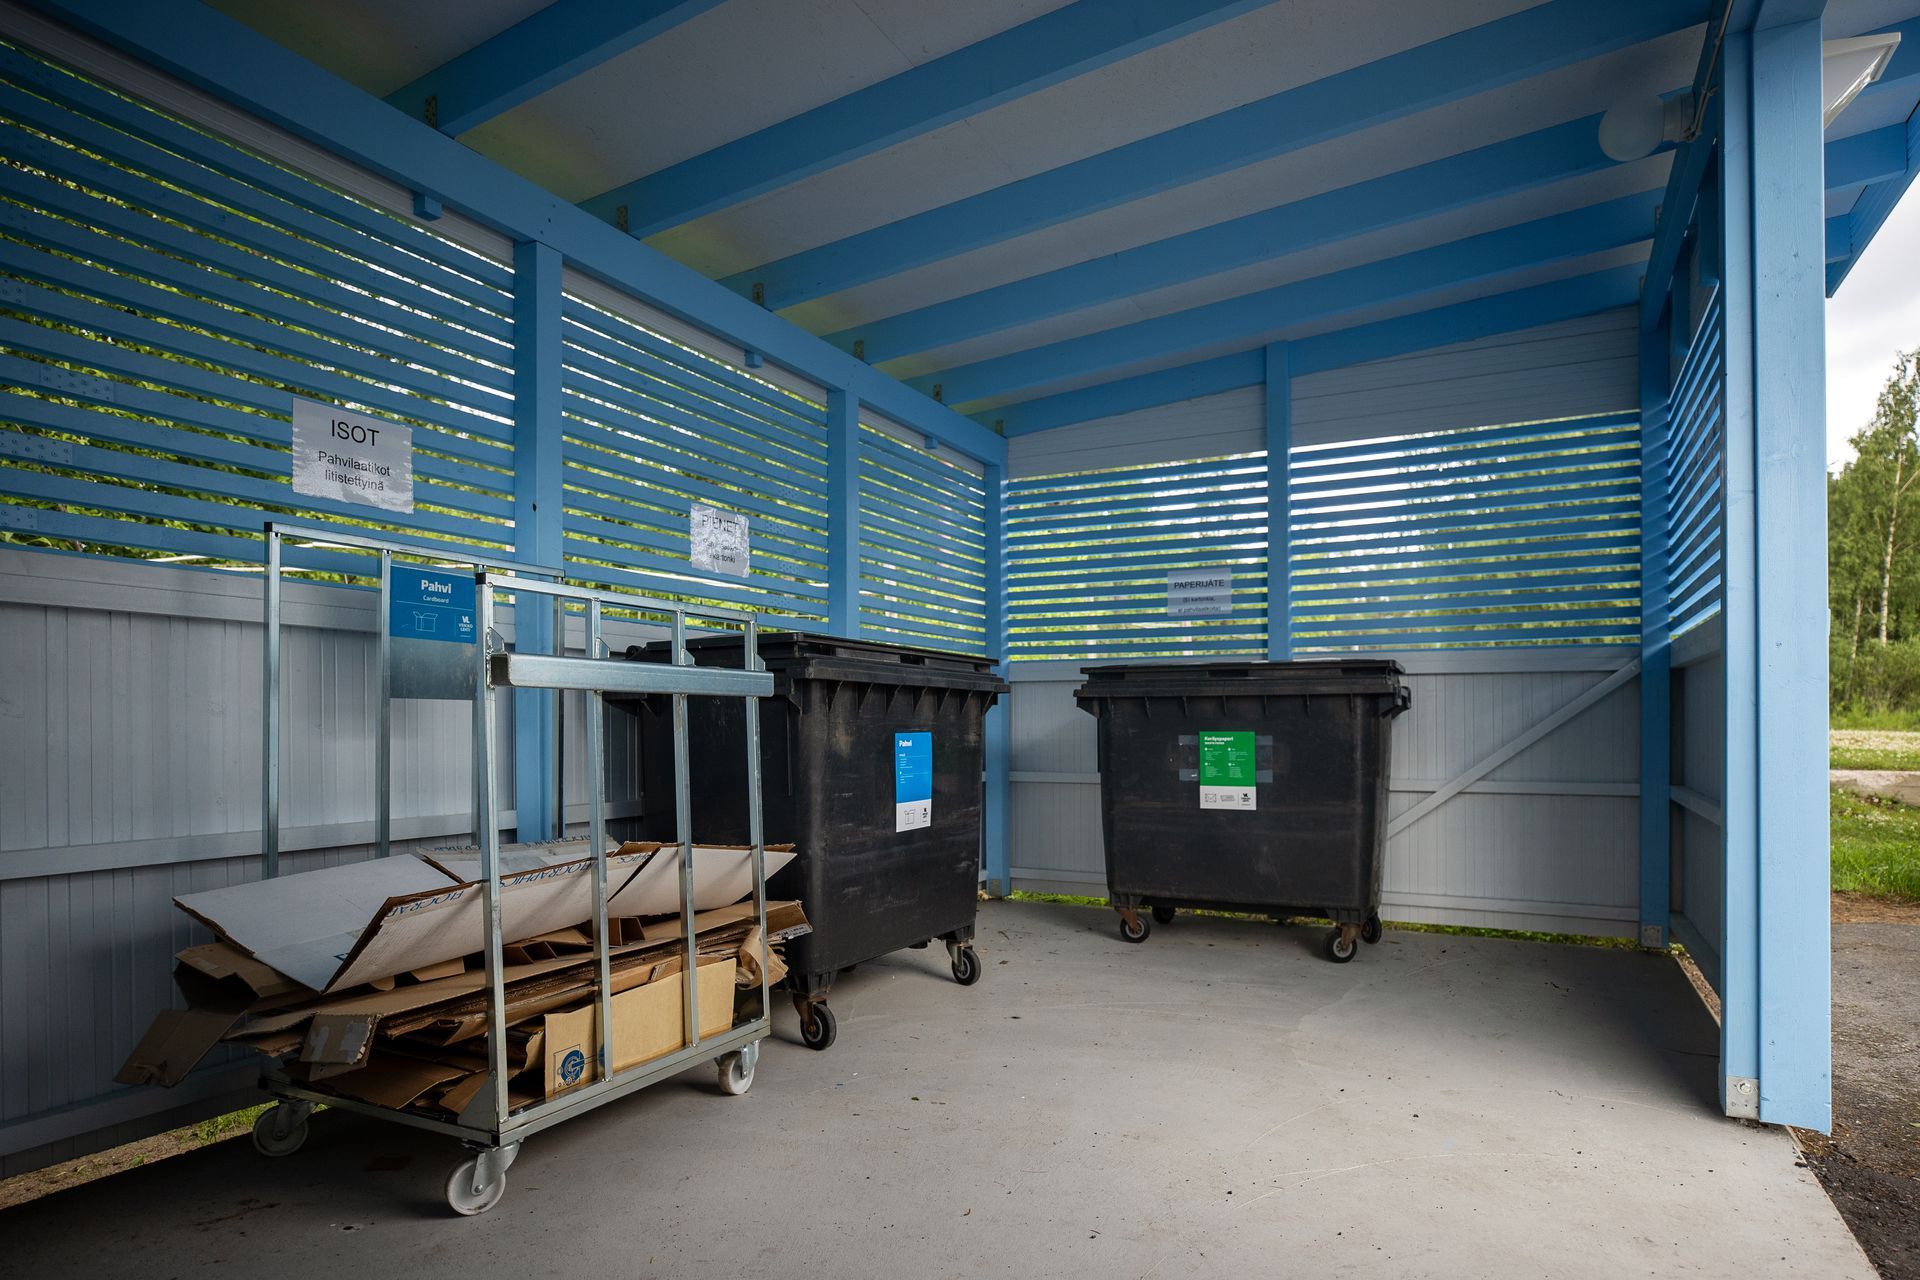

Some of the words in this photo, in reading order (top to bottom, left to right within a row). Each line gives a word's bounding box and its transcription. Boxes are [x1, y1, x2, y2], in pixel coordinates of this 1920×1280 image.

[331, 419, 380, 447] ISOT
[318, 450, 391, 477] Pahvilaatikot
[325, 469, 385, 492] litistettyinä
[420, 579, 452, 594] Pahvi
[1174, 579, 1225, 589] PAPERIJÄTE
[422, 594, 450, 604] Cardboard
